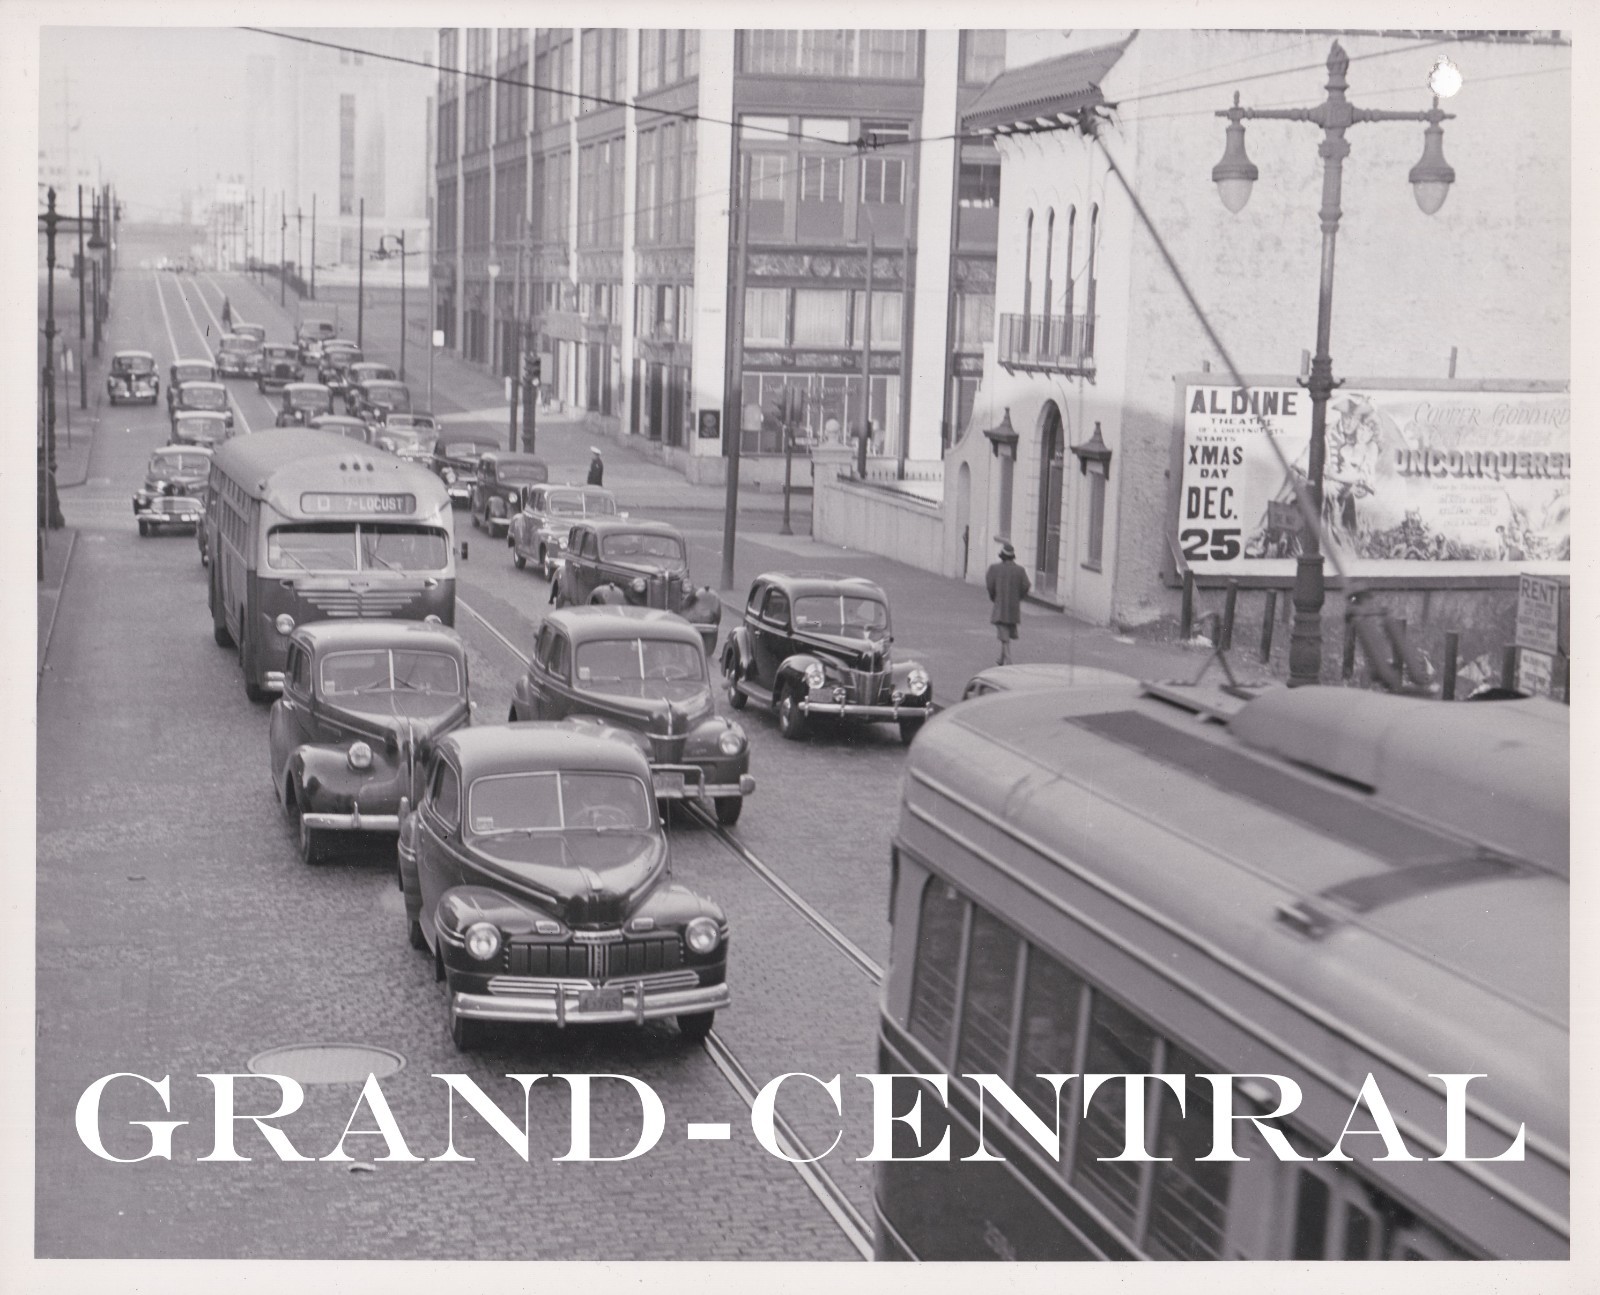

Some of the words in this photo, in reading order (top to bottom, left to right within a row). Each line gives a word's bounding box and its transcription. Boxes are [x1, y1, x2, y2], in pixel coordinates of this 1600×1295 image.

[1190, 388, 1299, 416] ALDINE
[1414, 401, 1481, 426] COOPER
[1195, 435, 1237, 443] STARTS
[1188, 444, 1244, 466] XMAS
[1200, 468, 1229, 479] DAY
[1186, 485, 1239, 520] DEC.
[1179, 527, 1242, 561] 25
[1520, 577, 1558, 604] RENT
